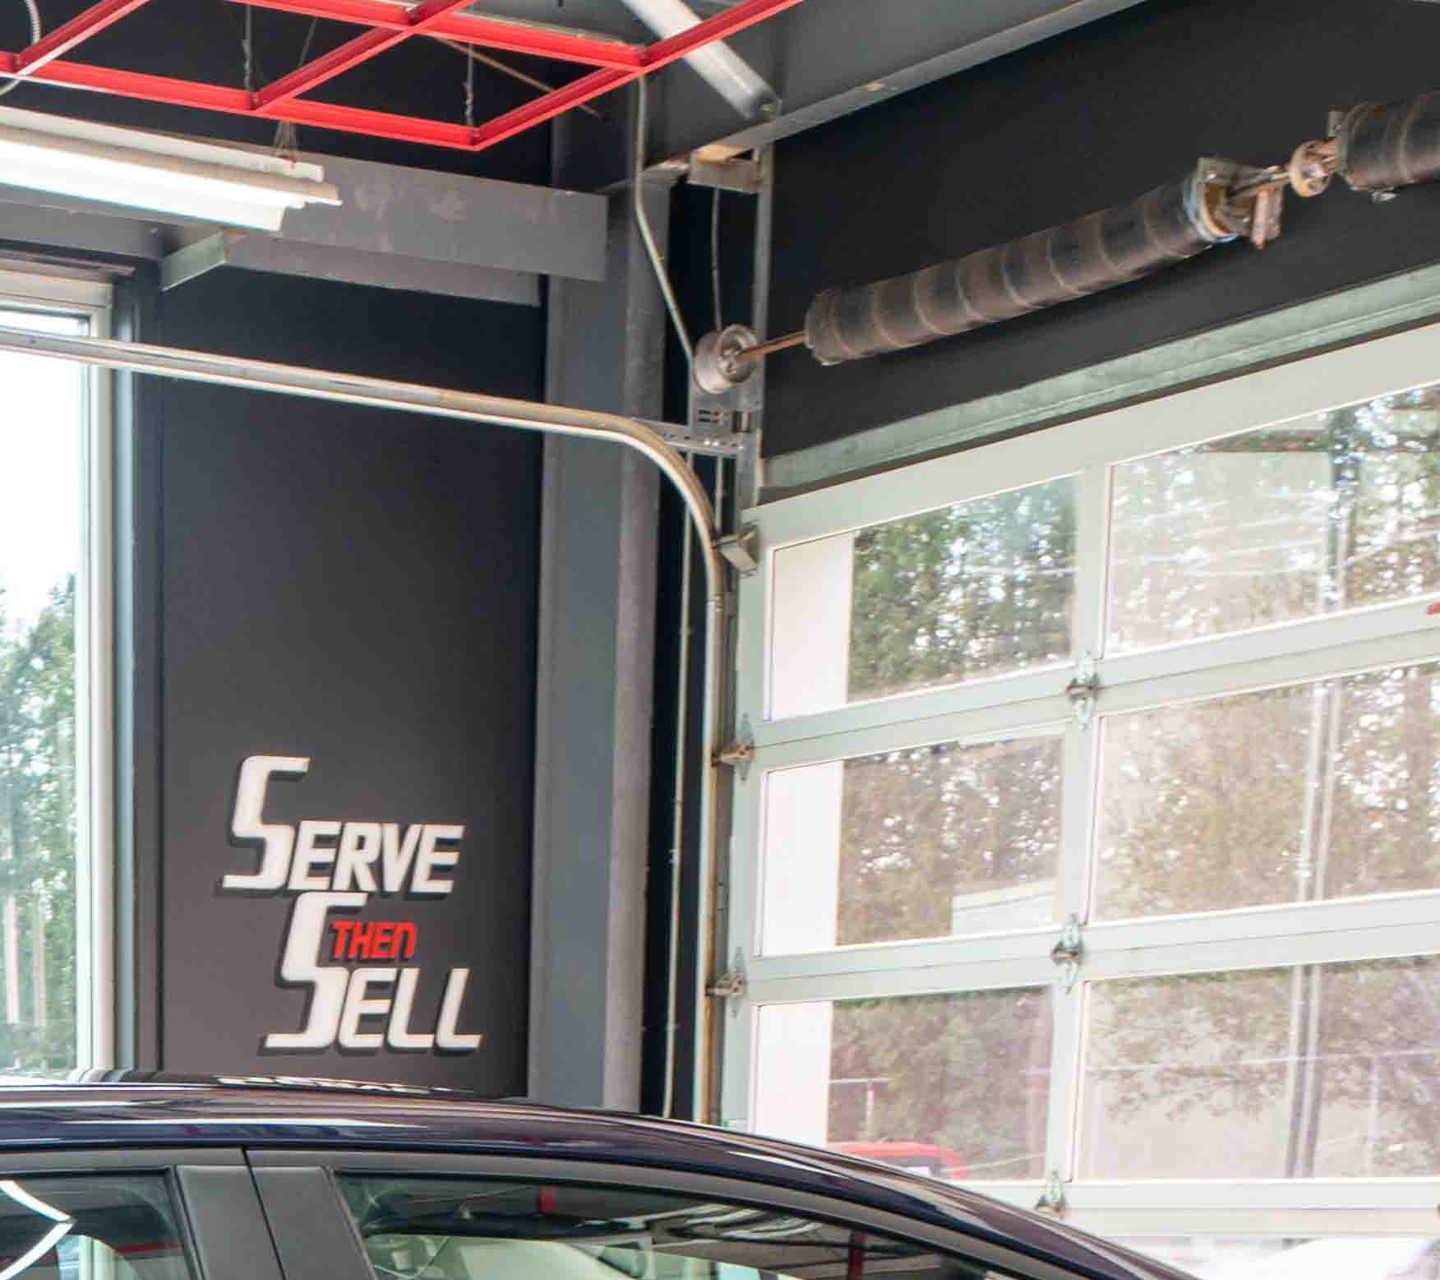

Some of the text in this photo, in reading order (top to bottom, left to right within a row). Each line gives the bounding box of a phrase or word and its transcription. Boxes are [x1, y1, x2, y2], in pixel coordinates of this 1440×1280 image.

[222, 755, 467, 894] SERVE
[264, 891, 483, 1050] SELL
[330, 920, 419, 960] THEN
